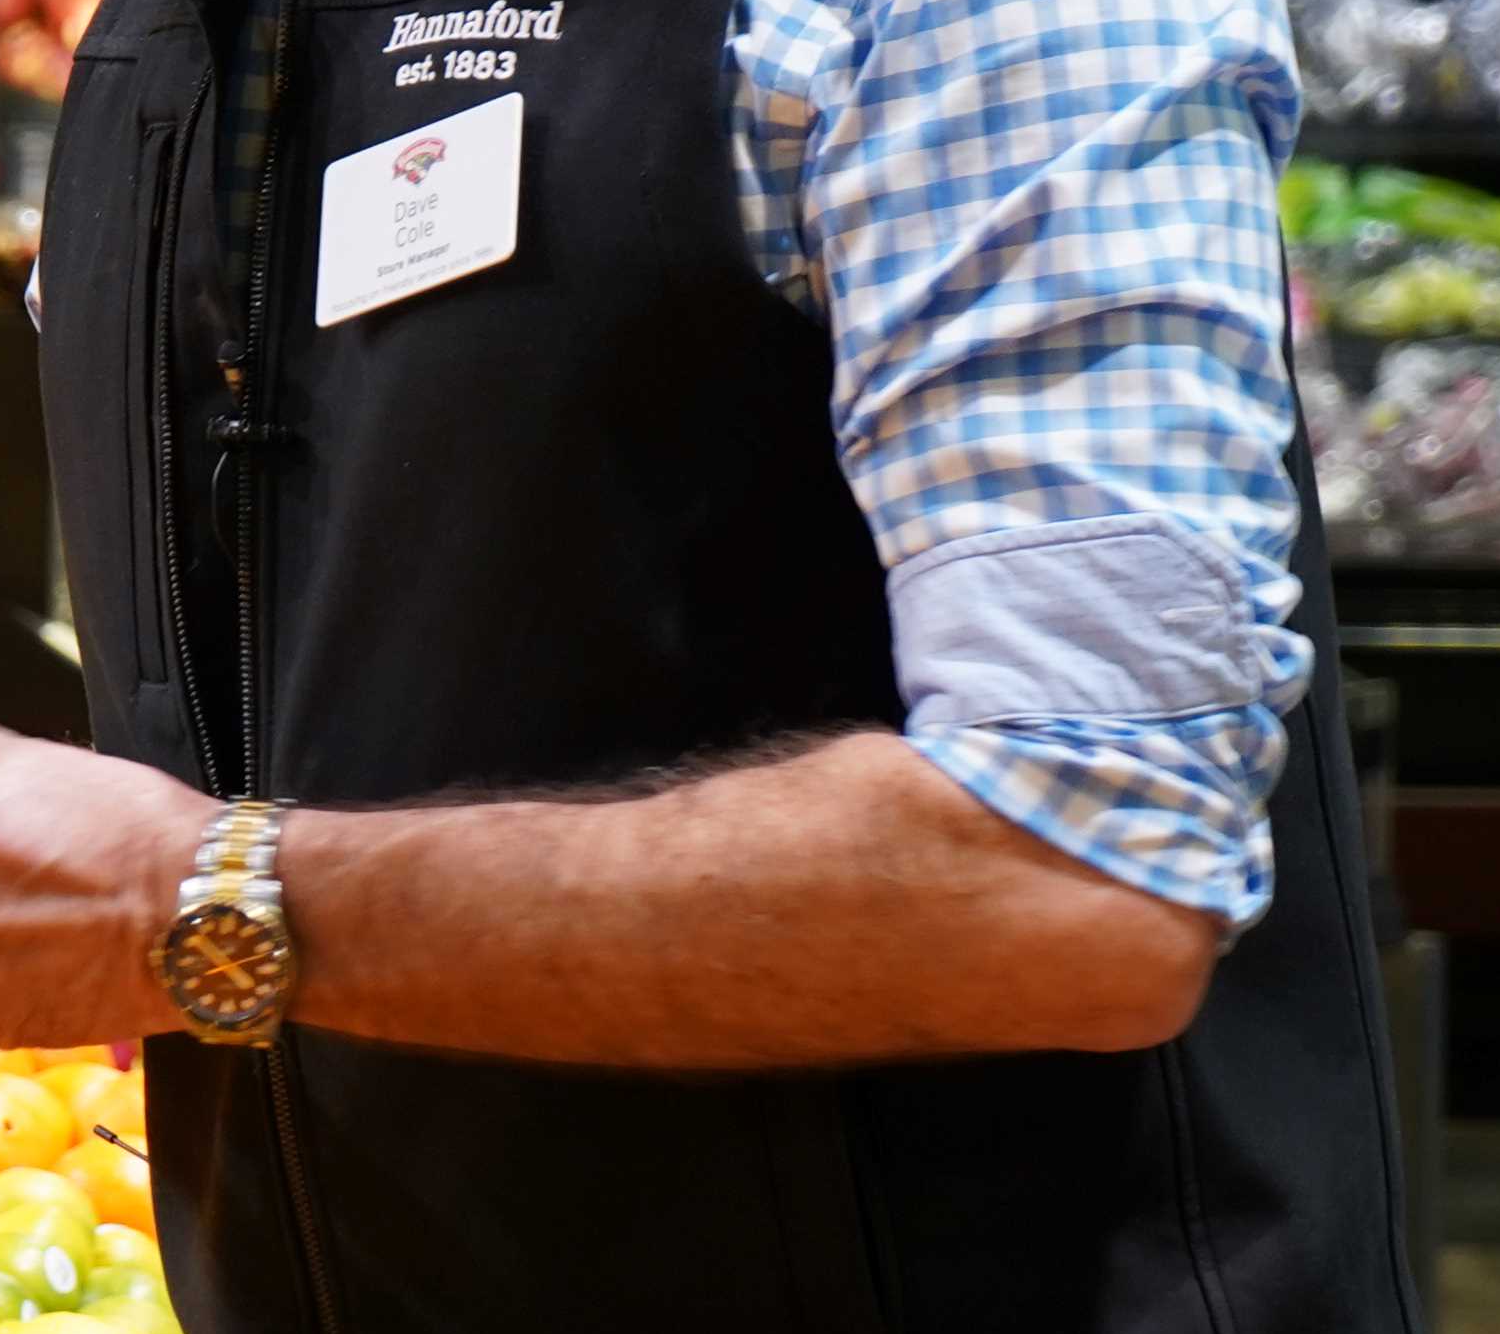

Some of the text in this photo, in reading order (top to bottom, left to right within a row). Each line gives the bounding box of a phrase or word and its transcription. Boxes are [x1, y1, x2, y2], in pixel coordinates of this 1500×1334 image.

[382, 0, 565, 53] Hannaford
[395, 49, 517, 87] est. 1883
[394, 192, 439, 223] Dave
[395, 220, 435, 248] Cole
[376, 242, 451, 278] Store Manager
